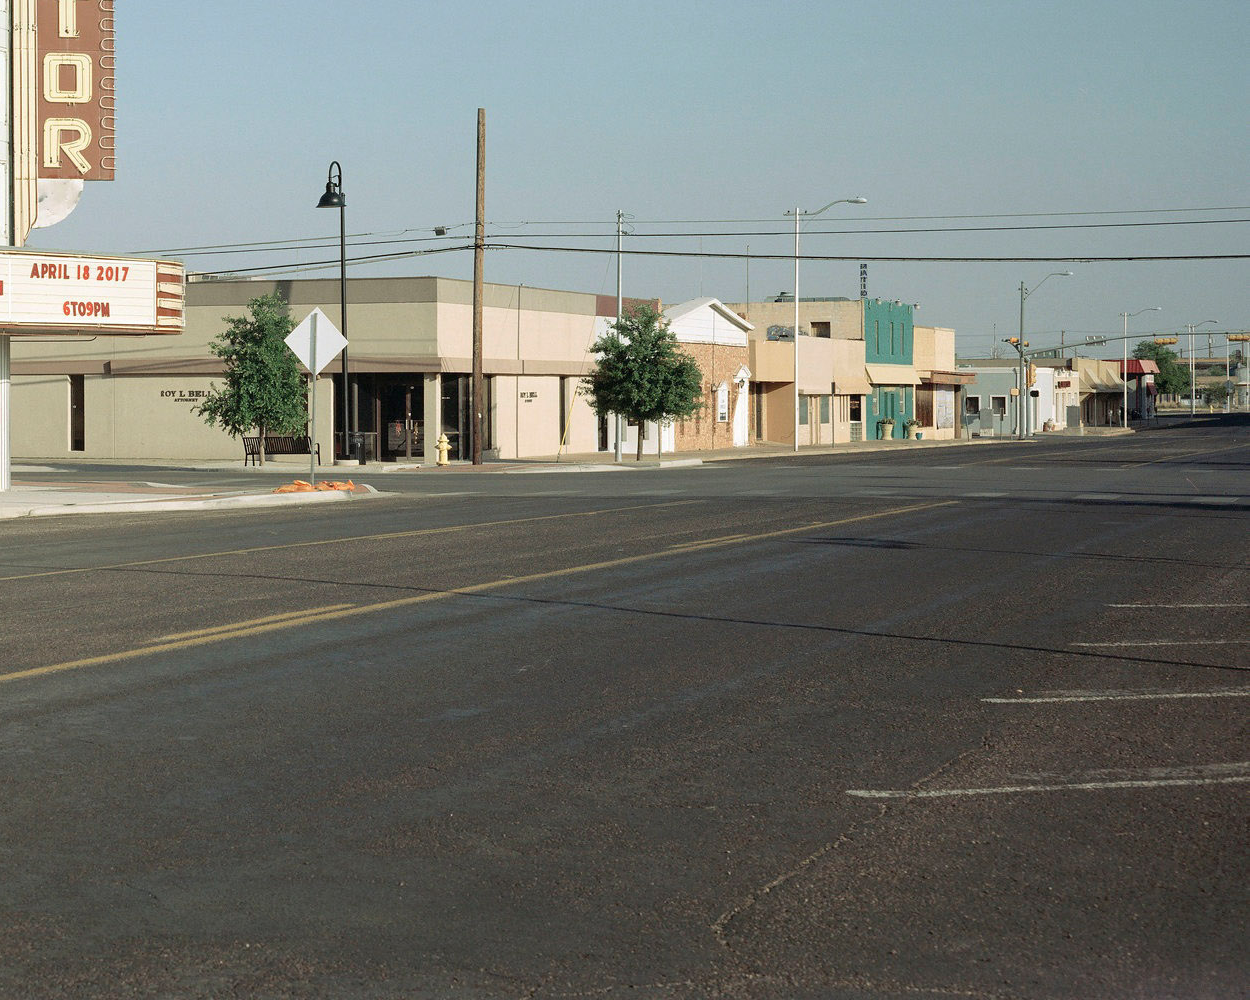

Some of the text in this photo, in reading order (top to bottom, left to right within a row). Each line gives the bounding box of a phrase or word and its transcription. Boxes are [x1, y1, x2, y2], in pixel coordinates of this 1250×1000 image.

[30, 263, 129, 281] APRIL 18 2017
[63, 301, 110, 317] 6TO9PM
